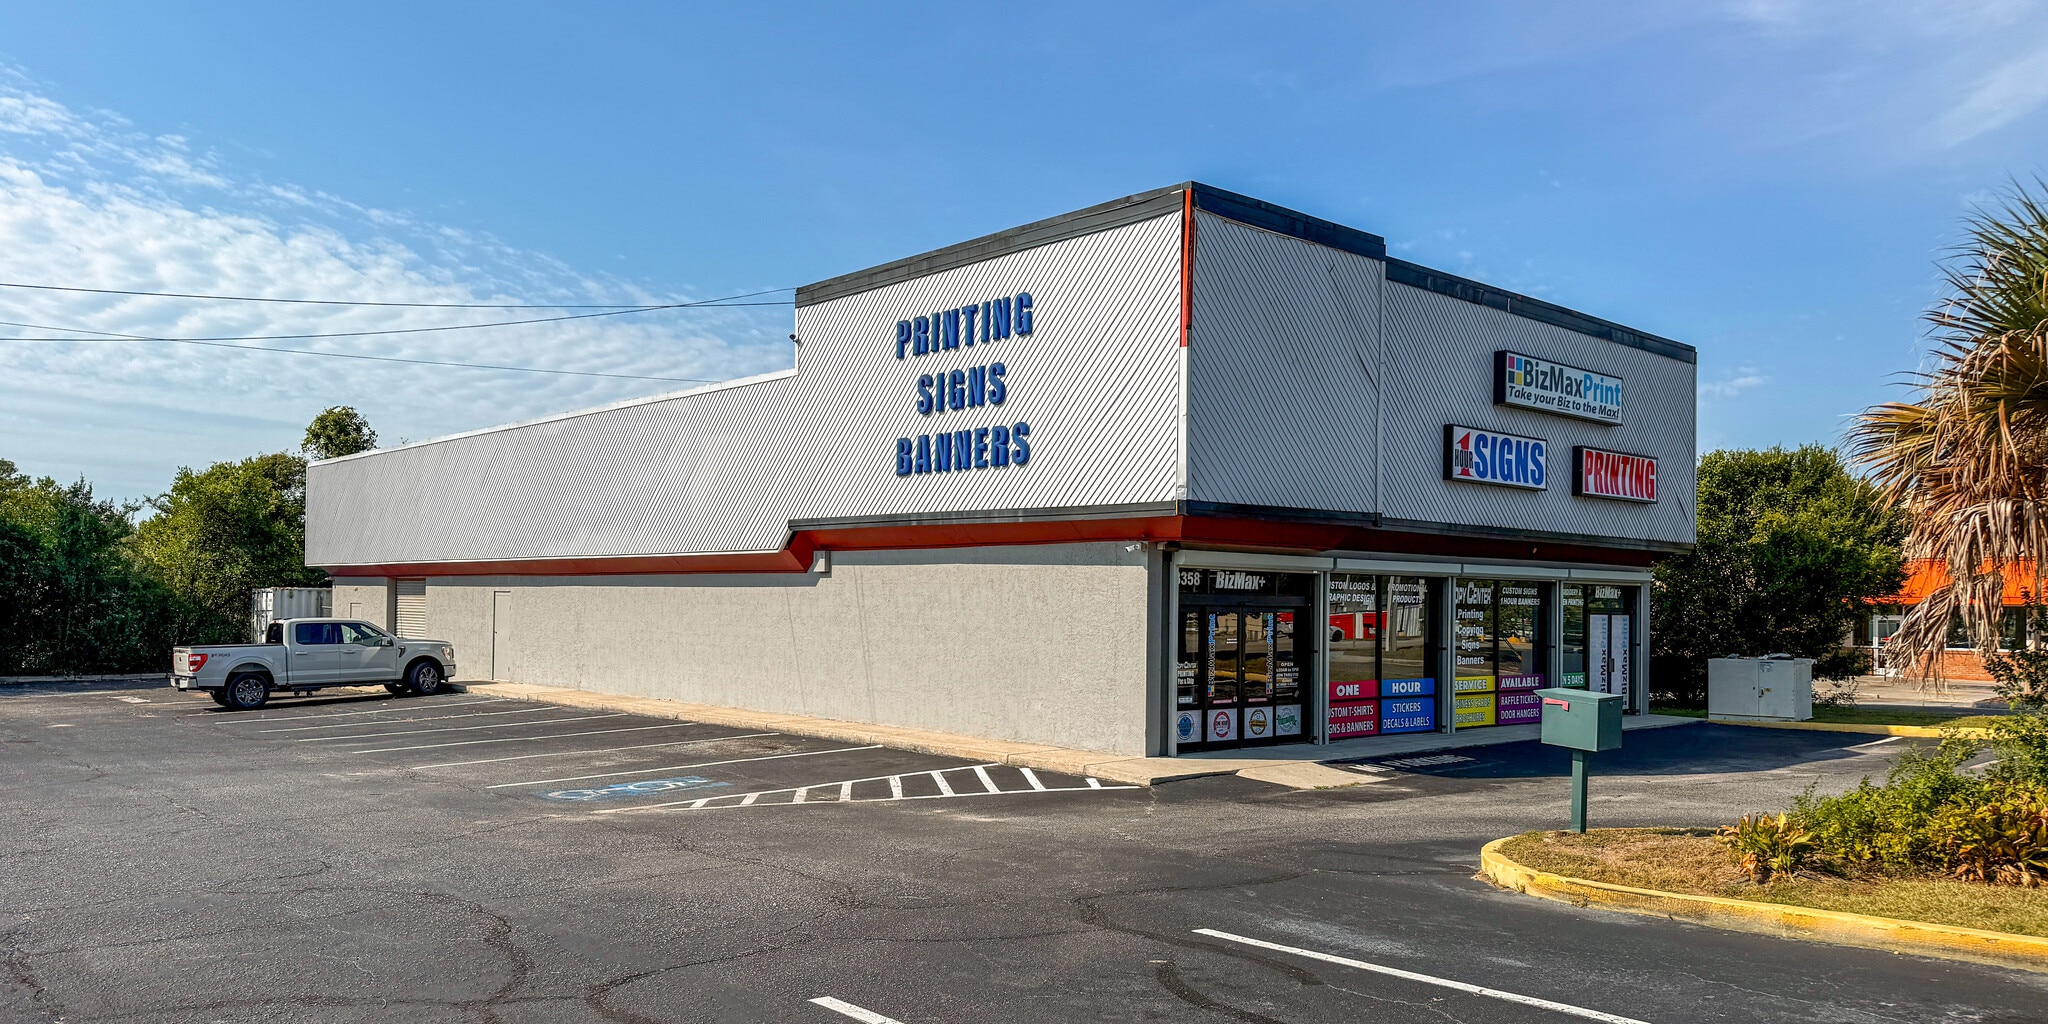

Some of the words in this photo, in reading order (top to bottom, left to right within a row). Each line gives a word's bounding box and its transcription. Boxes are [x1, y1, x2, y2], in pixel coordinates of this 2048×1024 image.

[896, 291, 1033, 360] PRINTING
[917, 362, 1006, 415] SIGNS
[1523, 359, 1621, 406] BizMaxPrint
[1508, 386, 1532, 401] Take
[1534, 393, 1555, 406] your
[1557, 396, 1571, 410] Biz
[1572, 400, 1581, 411] to
[1582, 402, 1597, 414] the
[1599, 405, 1619, 419] Max!
[896, 421, 1031, 476] BANNERS
[1456, 431, 1474, 477] 1
[1455, 449, 1473, 469] HOUR
[1474, 433, 1544, 485] SIGNS
[1584, 450, 1655, 500] PRINTING
[1329, 581, 1348, 590] STOM
[1349, 582, 1370, 591] LOGOS
[1387, 583, 1428, 593] PROMOTIONL
[1502, 587, 1522, 595] CUSTOM
[1523, 587, 1538, 596] SIGNS
[1352, 593, 1375, 602] DESIGN
[1392, 594, 1423, 604] PRODUCTS
[1504, 597, 1517, 605] HOUR
[1518, 598, 1540, 606] BANNERS
[1457, 609, 1483, 621] Printing
[1457, 624, 1484, 637] Copying
[1461, 639, 1480, 652] Signs
[1457, 655, 1484, 665] Banners
[1454, 679, 1487, 690] SERVICE
[1501, 677, 1539, 688] AVAILABLE
[1571, 675, 1584, 684] DAYS
[1336, 684, 1360, 697] ONE
[1391, 681, 1421, 694] HOUR
[1501, 695, 1519, 706] RAFFLE
[1520, 694, 1540, 704] TICKETS
[1348, 705, 1374, 716] T-SHIRTS
[1392, 702, 1421, 713] STICKERS
[1501, 710, 1516, 720] DOOR
[1516, 708, 1540, 718] HANGERS
[1341, 722, 1346, 733] &
[1346, 720, 1374, 732] BANNERS
[1383, 718, 1403, 729] DECALS
[1404, 718, 1409, 728] &
[1410, 716, 1429, 727] LABELS
